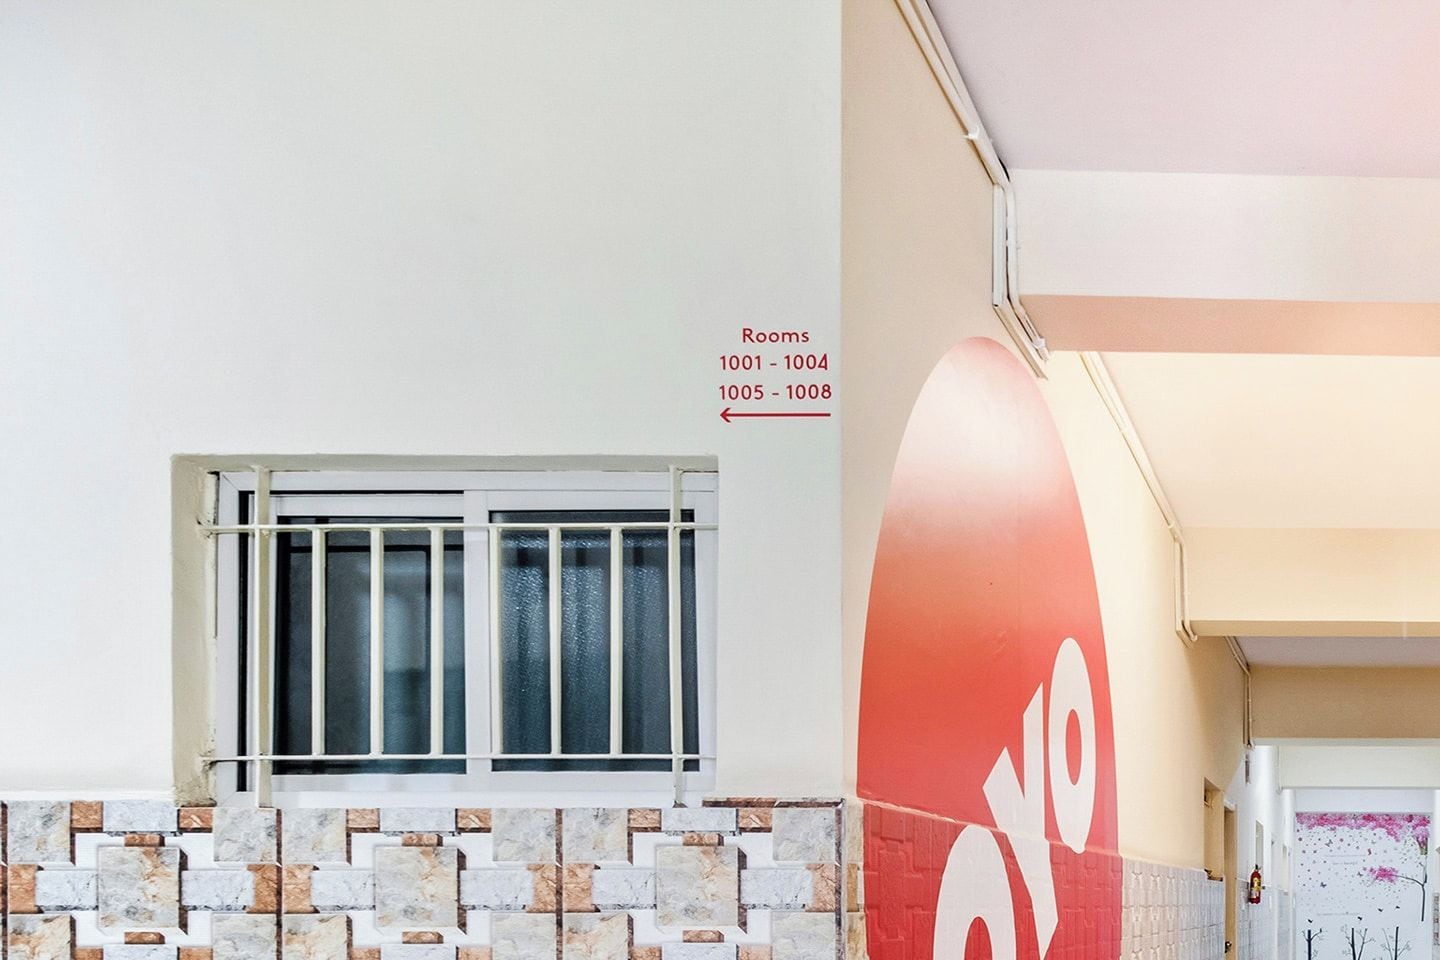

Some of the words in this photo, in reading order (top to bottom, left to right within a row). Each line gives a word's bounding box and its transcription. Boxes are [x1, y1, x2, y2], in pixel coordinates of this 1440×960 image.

[742, 328, 810, 343] Rooms
[719, 355, 761, 370] 1001
[784, 353, 828, 370] 1004
[719, 385, 764, 400] 1005
[786, 384, 832, 399] 1008
